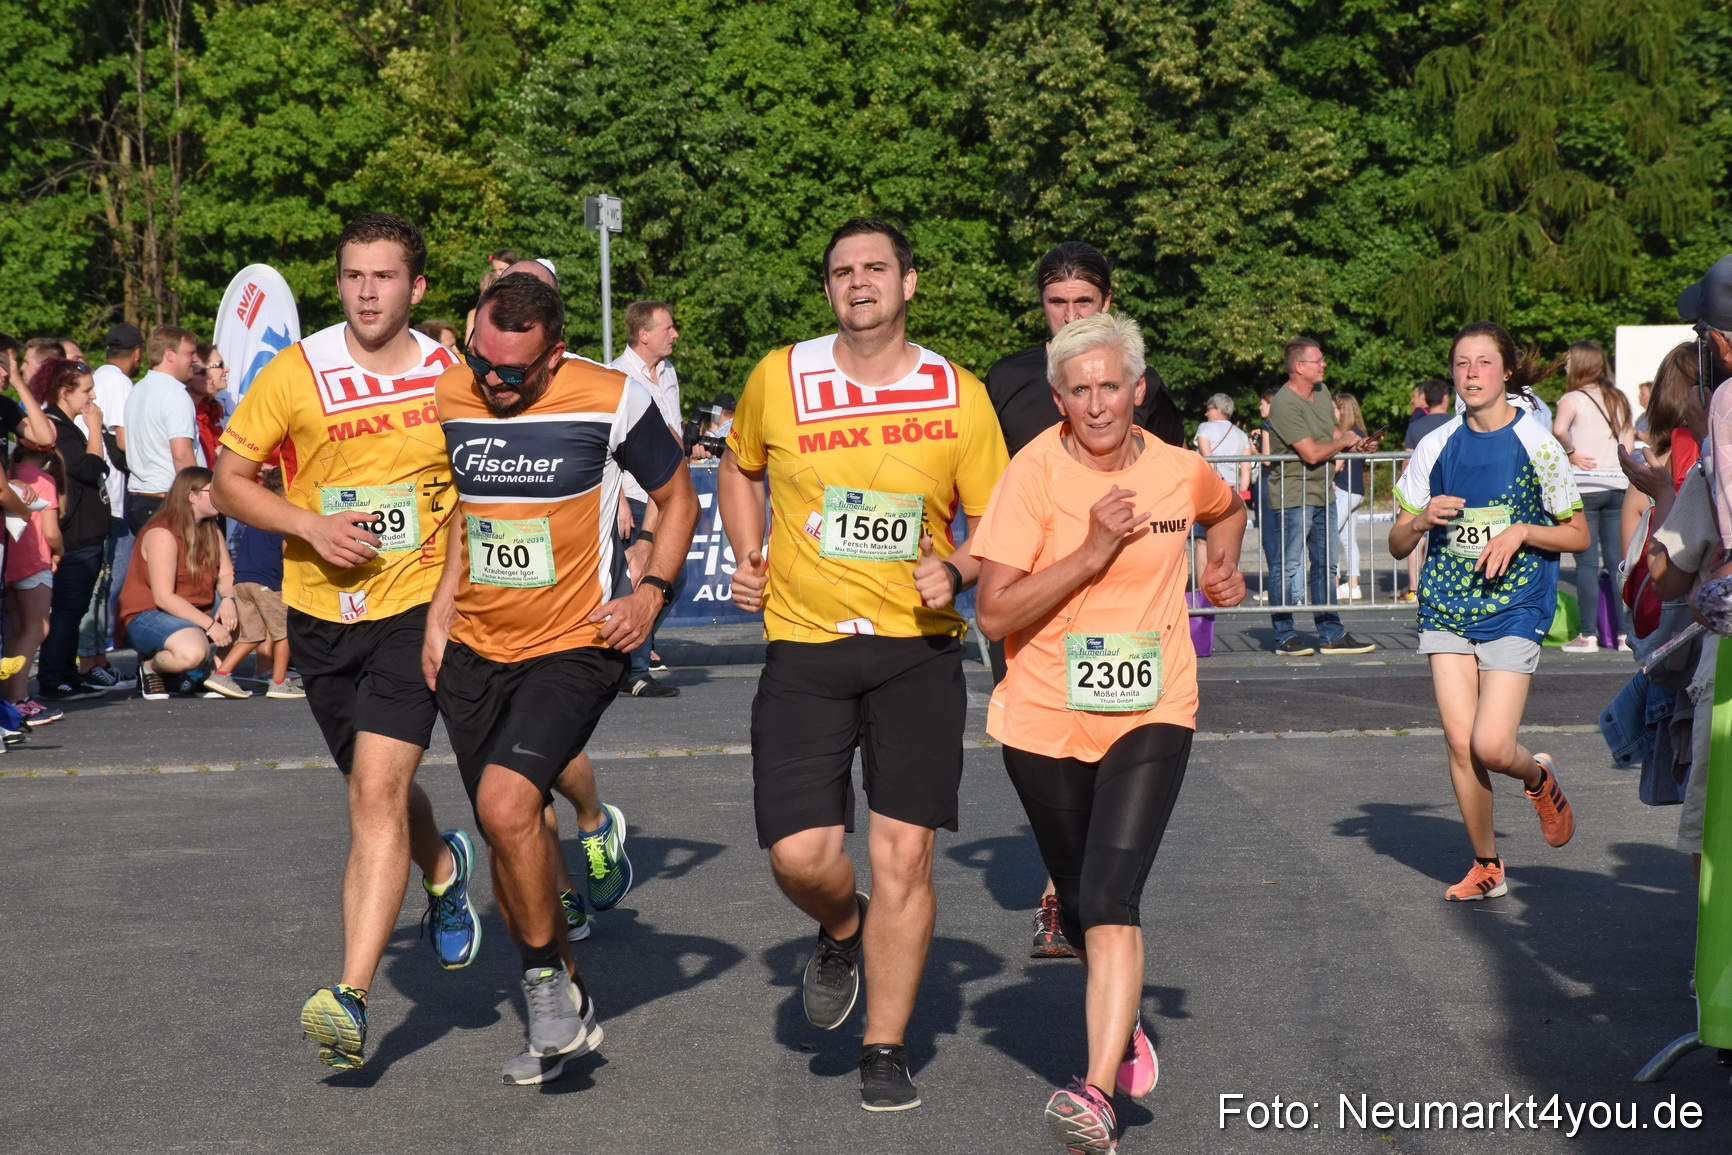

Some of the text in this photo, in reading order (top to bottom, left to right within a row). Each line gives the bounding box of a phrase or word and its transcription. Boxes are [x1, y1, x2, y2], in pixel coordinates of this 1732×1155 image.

[327, 401, 439, 442] MAX BÖ
[225, 425, 259, 452] boegl.de
[798, 417, 958, 454] MAX BÖGL
[465, 453, 563, 473] Fischer
[473, 474, 555, 483] AUTOMOBILE
[334, 499, 371, 508] firmenlauf
[838, 501, 877, 512] firmenlauf
[835, 513, 907, 542] 1560
[1150, 519, 1187, 533] THULE
[381, 533, 406, 541] Rudolf
[1455, 525, 1492, 544] 281
[843, 540, 868, 549] Fersch
[481, 542, 530, 568] 760
[484, 567, 534, 578] Krauberger Igor
[1079, 648, 1120, 657] firmenlauf
[1077, 660, 1152, 689] 2306
[1093, 690, 1118, 698] Mößel
